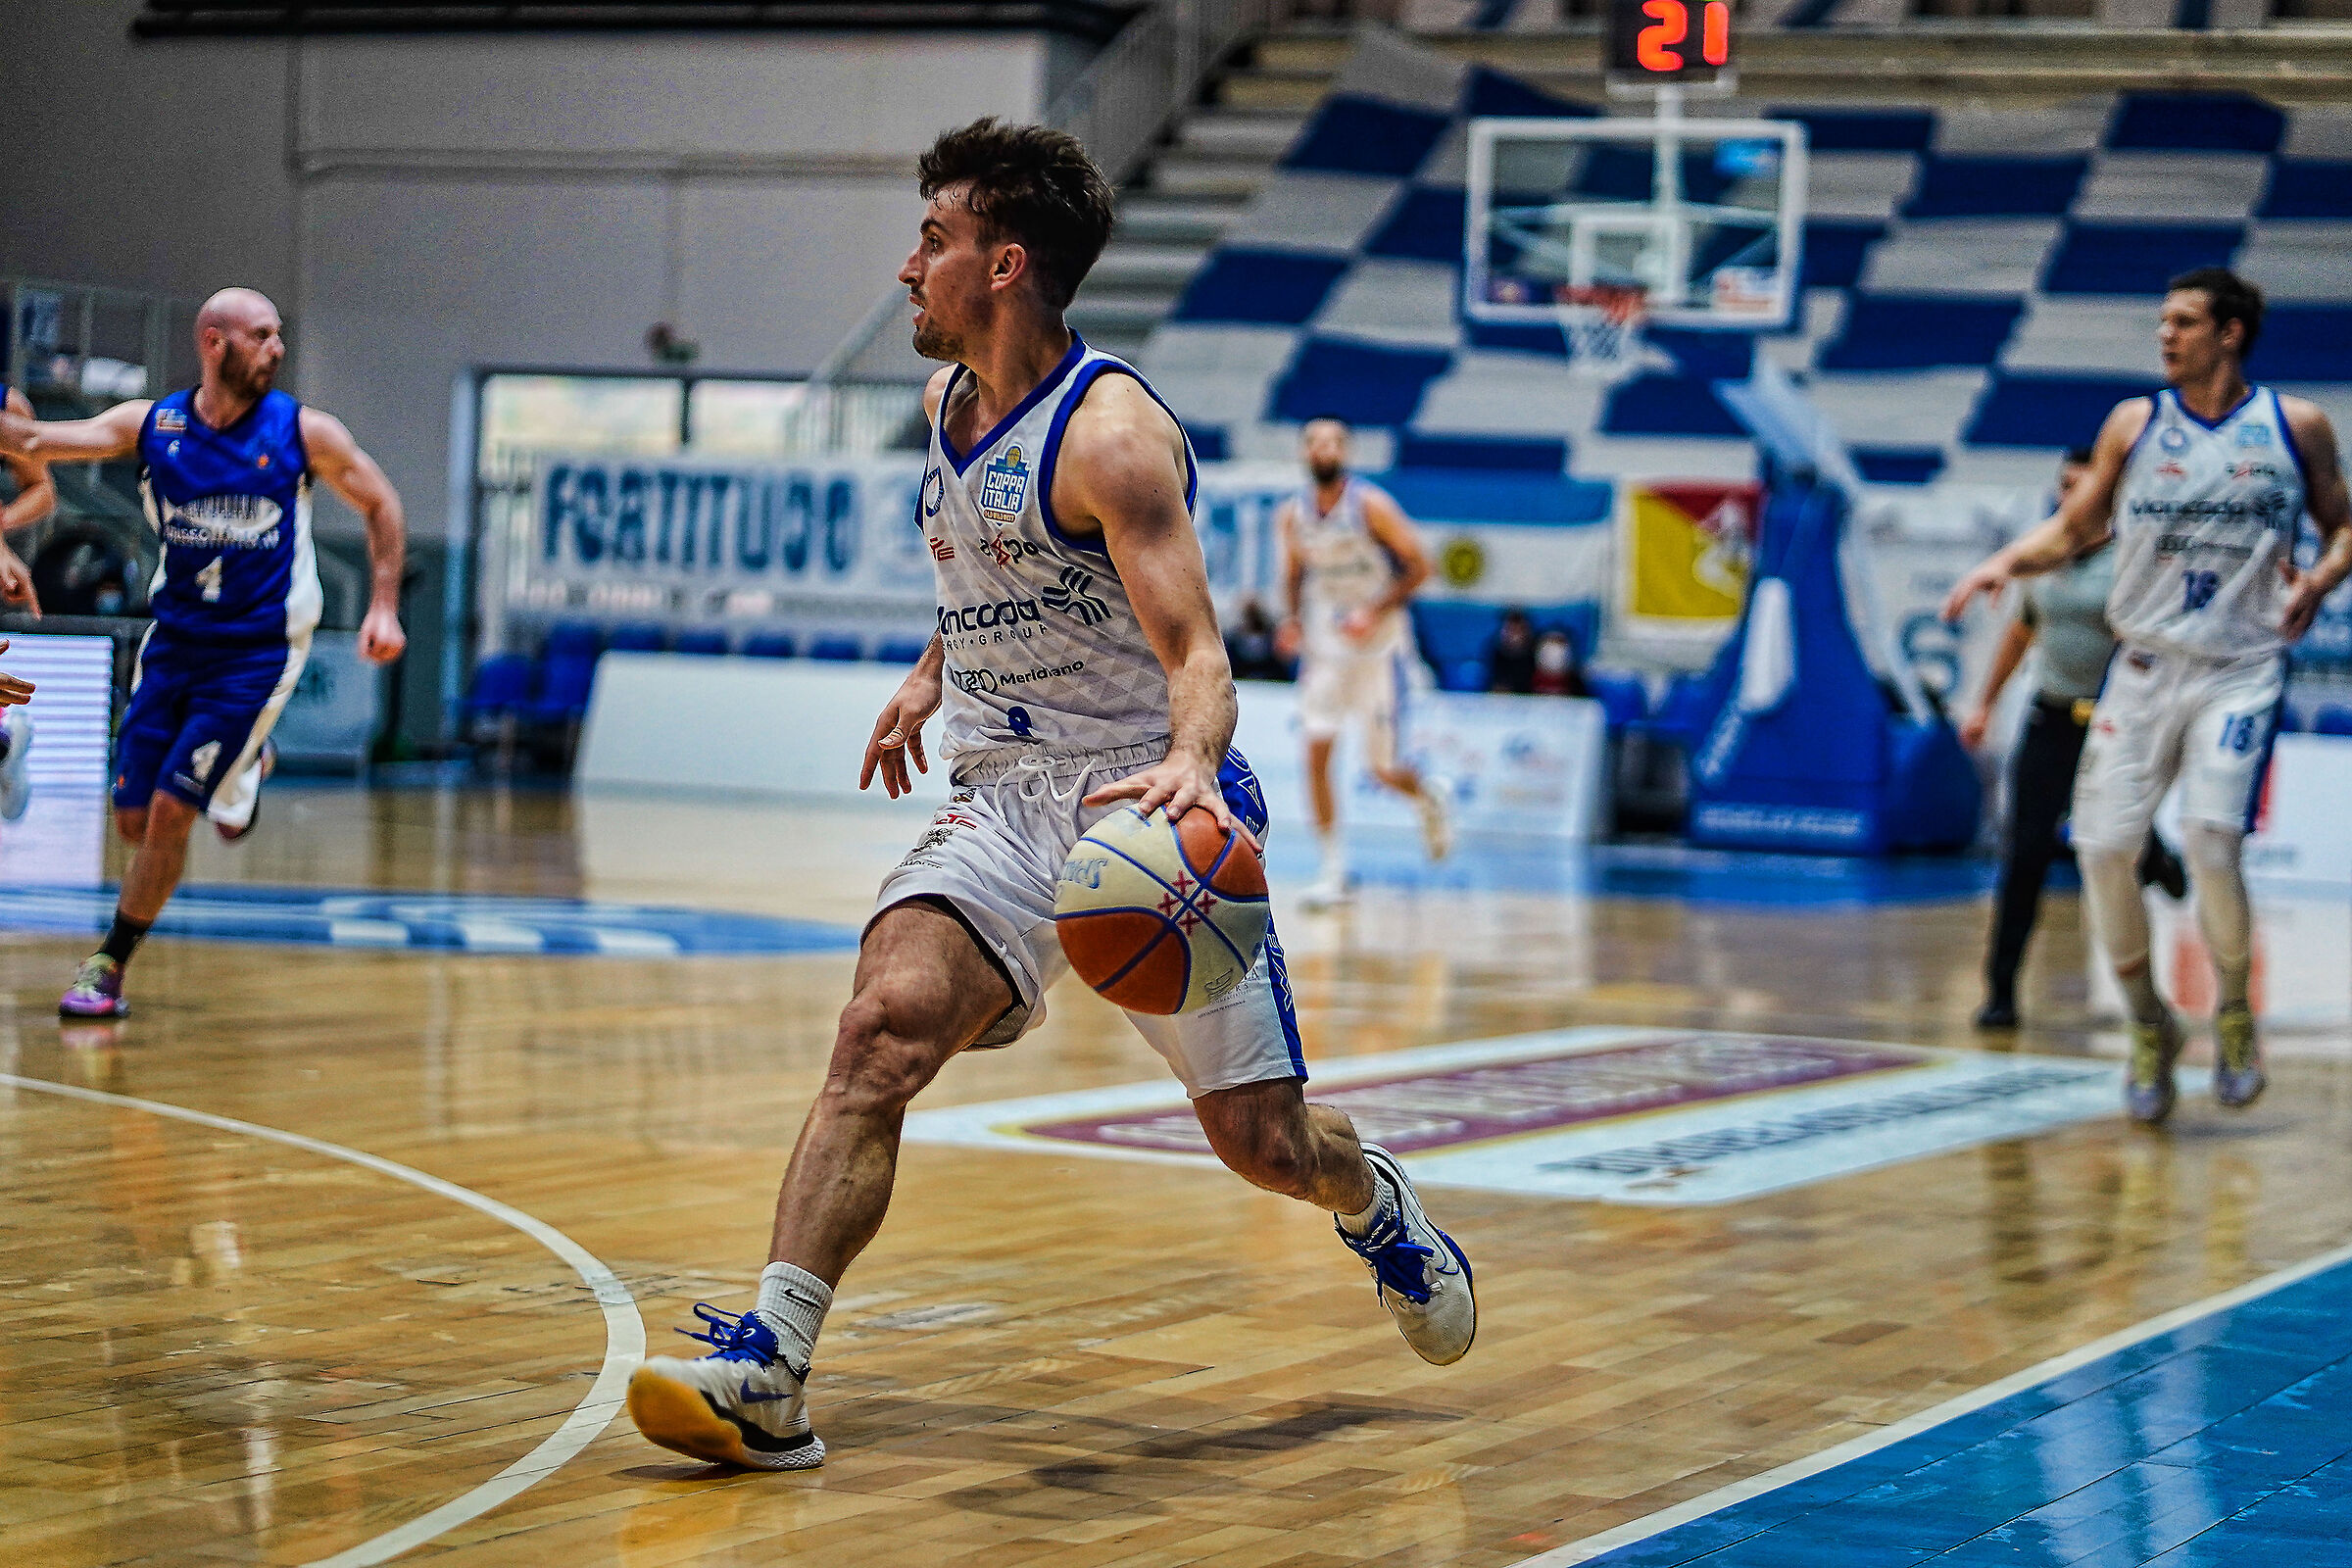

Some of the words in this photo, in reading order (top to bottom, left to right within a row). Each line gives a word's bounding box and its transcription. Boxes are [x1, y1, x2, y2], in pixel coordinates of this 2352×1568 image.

[1637, 0, 1730, 72] 21
[987, 470, 1025, 494] COPPA
[984, 488, 1020, 511] ITALIA
[195, 555, 222, 603] 4
[1000, 661, 1084, 686] Meridiano
[190, 739, 222, 783] 4
